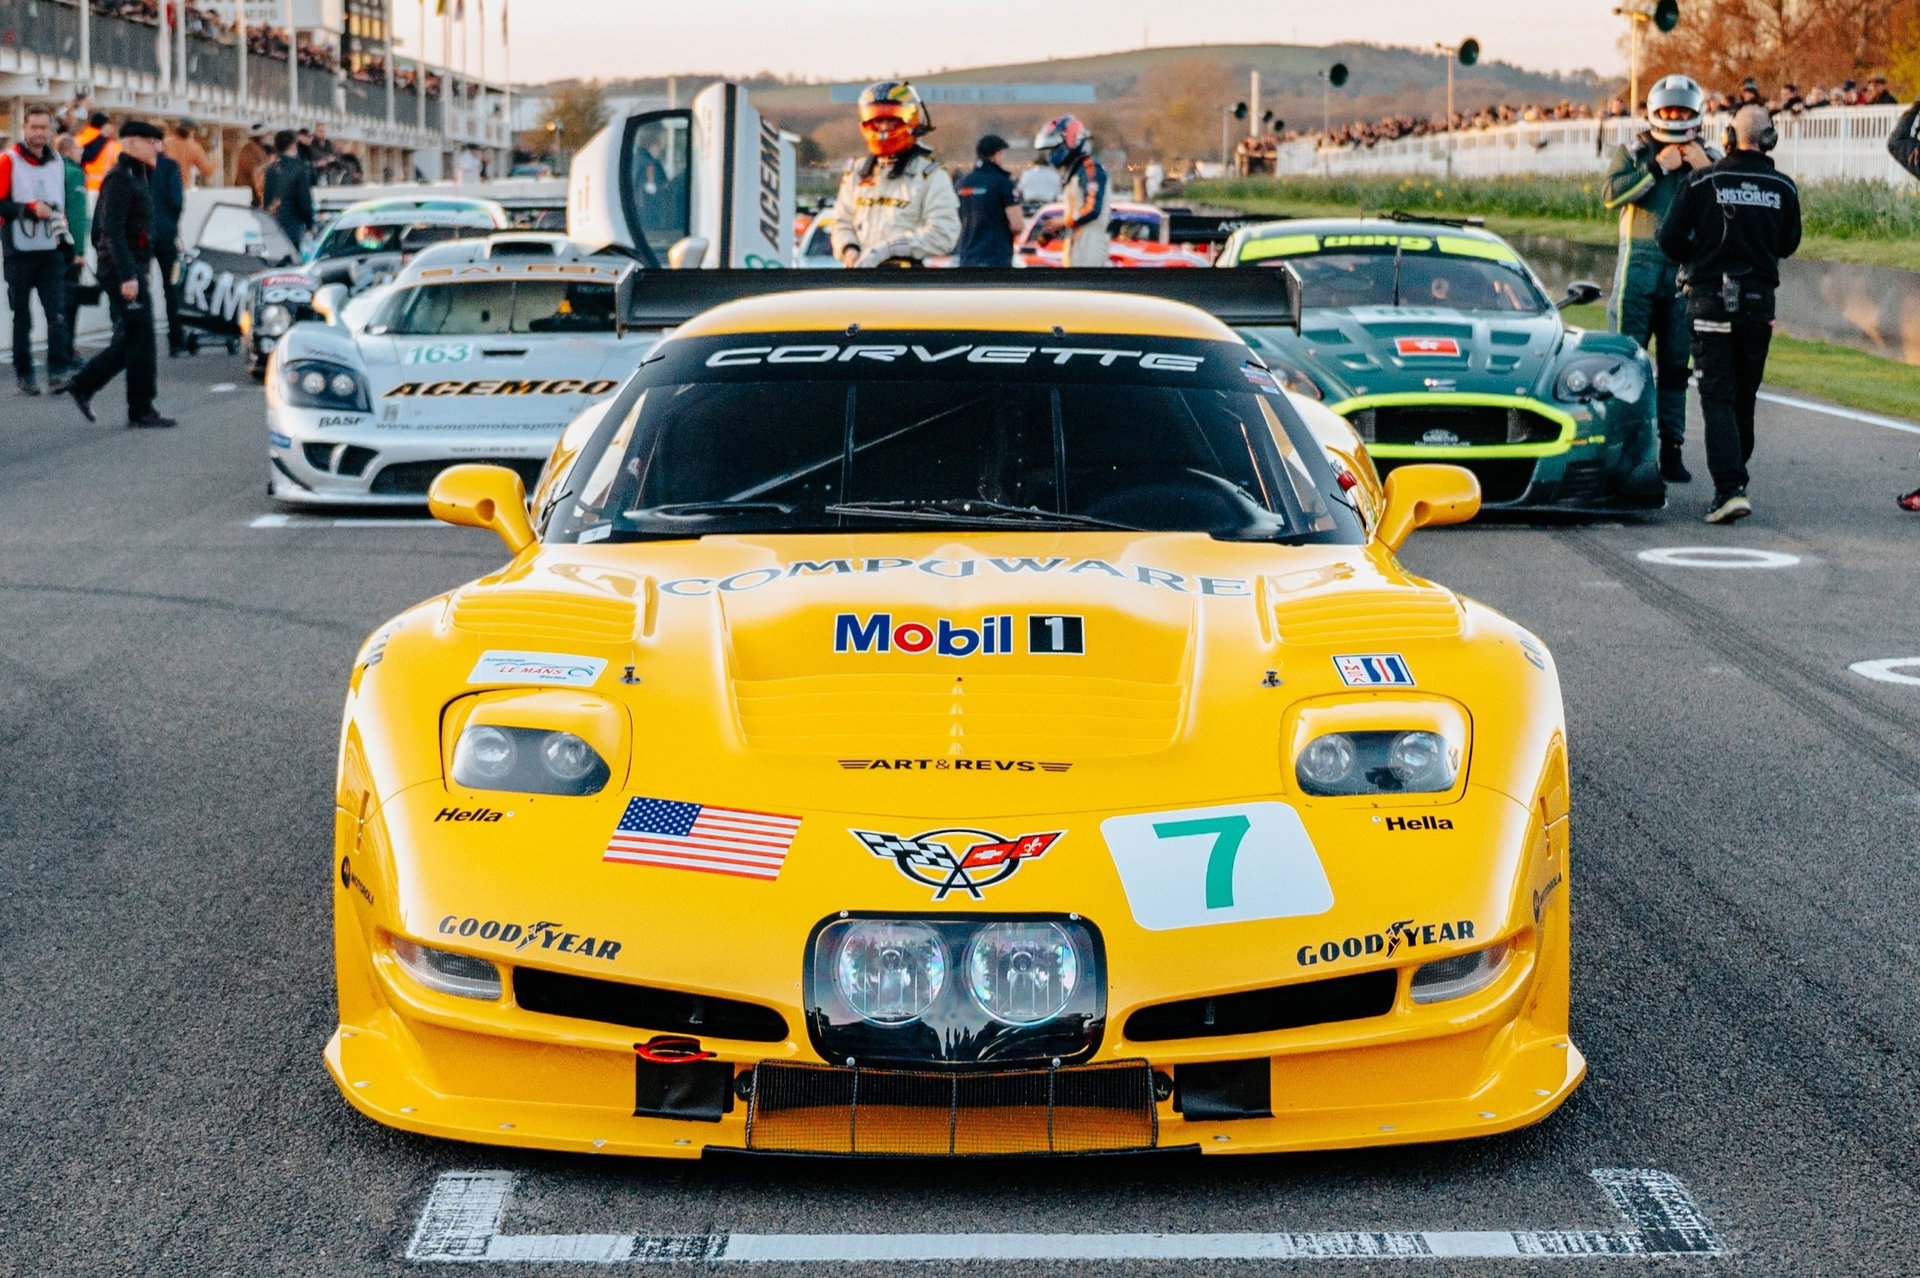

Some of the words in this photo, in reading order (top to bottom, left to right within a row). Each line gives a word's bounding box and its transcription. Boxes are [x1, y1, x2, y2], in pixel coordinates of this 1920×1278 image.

[1716, 188, 1781, 206] HISTORICS
[410, 344, 469, 364] 163
[705, 344, 1205, 373] CORVETTE
[382, 379, 618, 398] ACEMCO
[319, 416, 366, 429] BASF
[658, 557, 1253, 597] COMPUWARE
[834, 613, 1012, 657] Mobil
[499, 666, 519, 674] LE
[521, 667, 564, 675] MANS
[433, 807, 504, 823] Hella
[1385, 815, 1454, 831] Hella
[1152, 815, 1252, 911] 7
